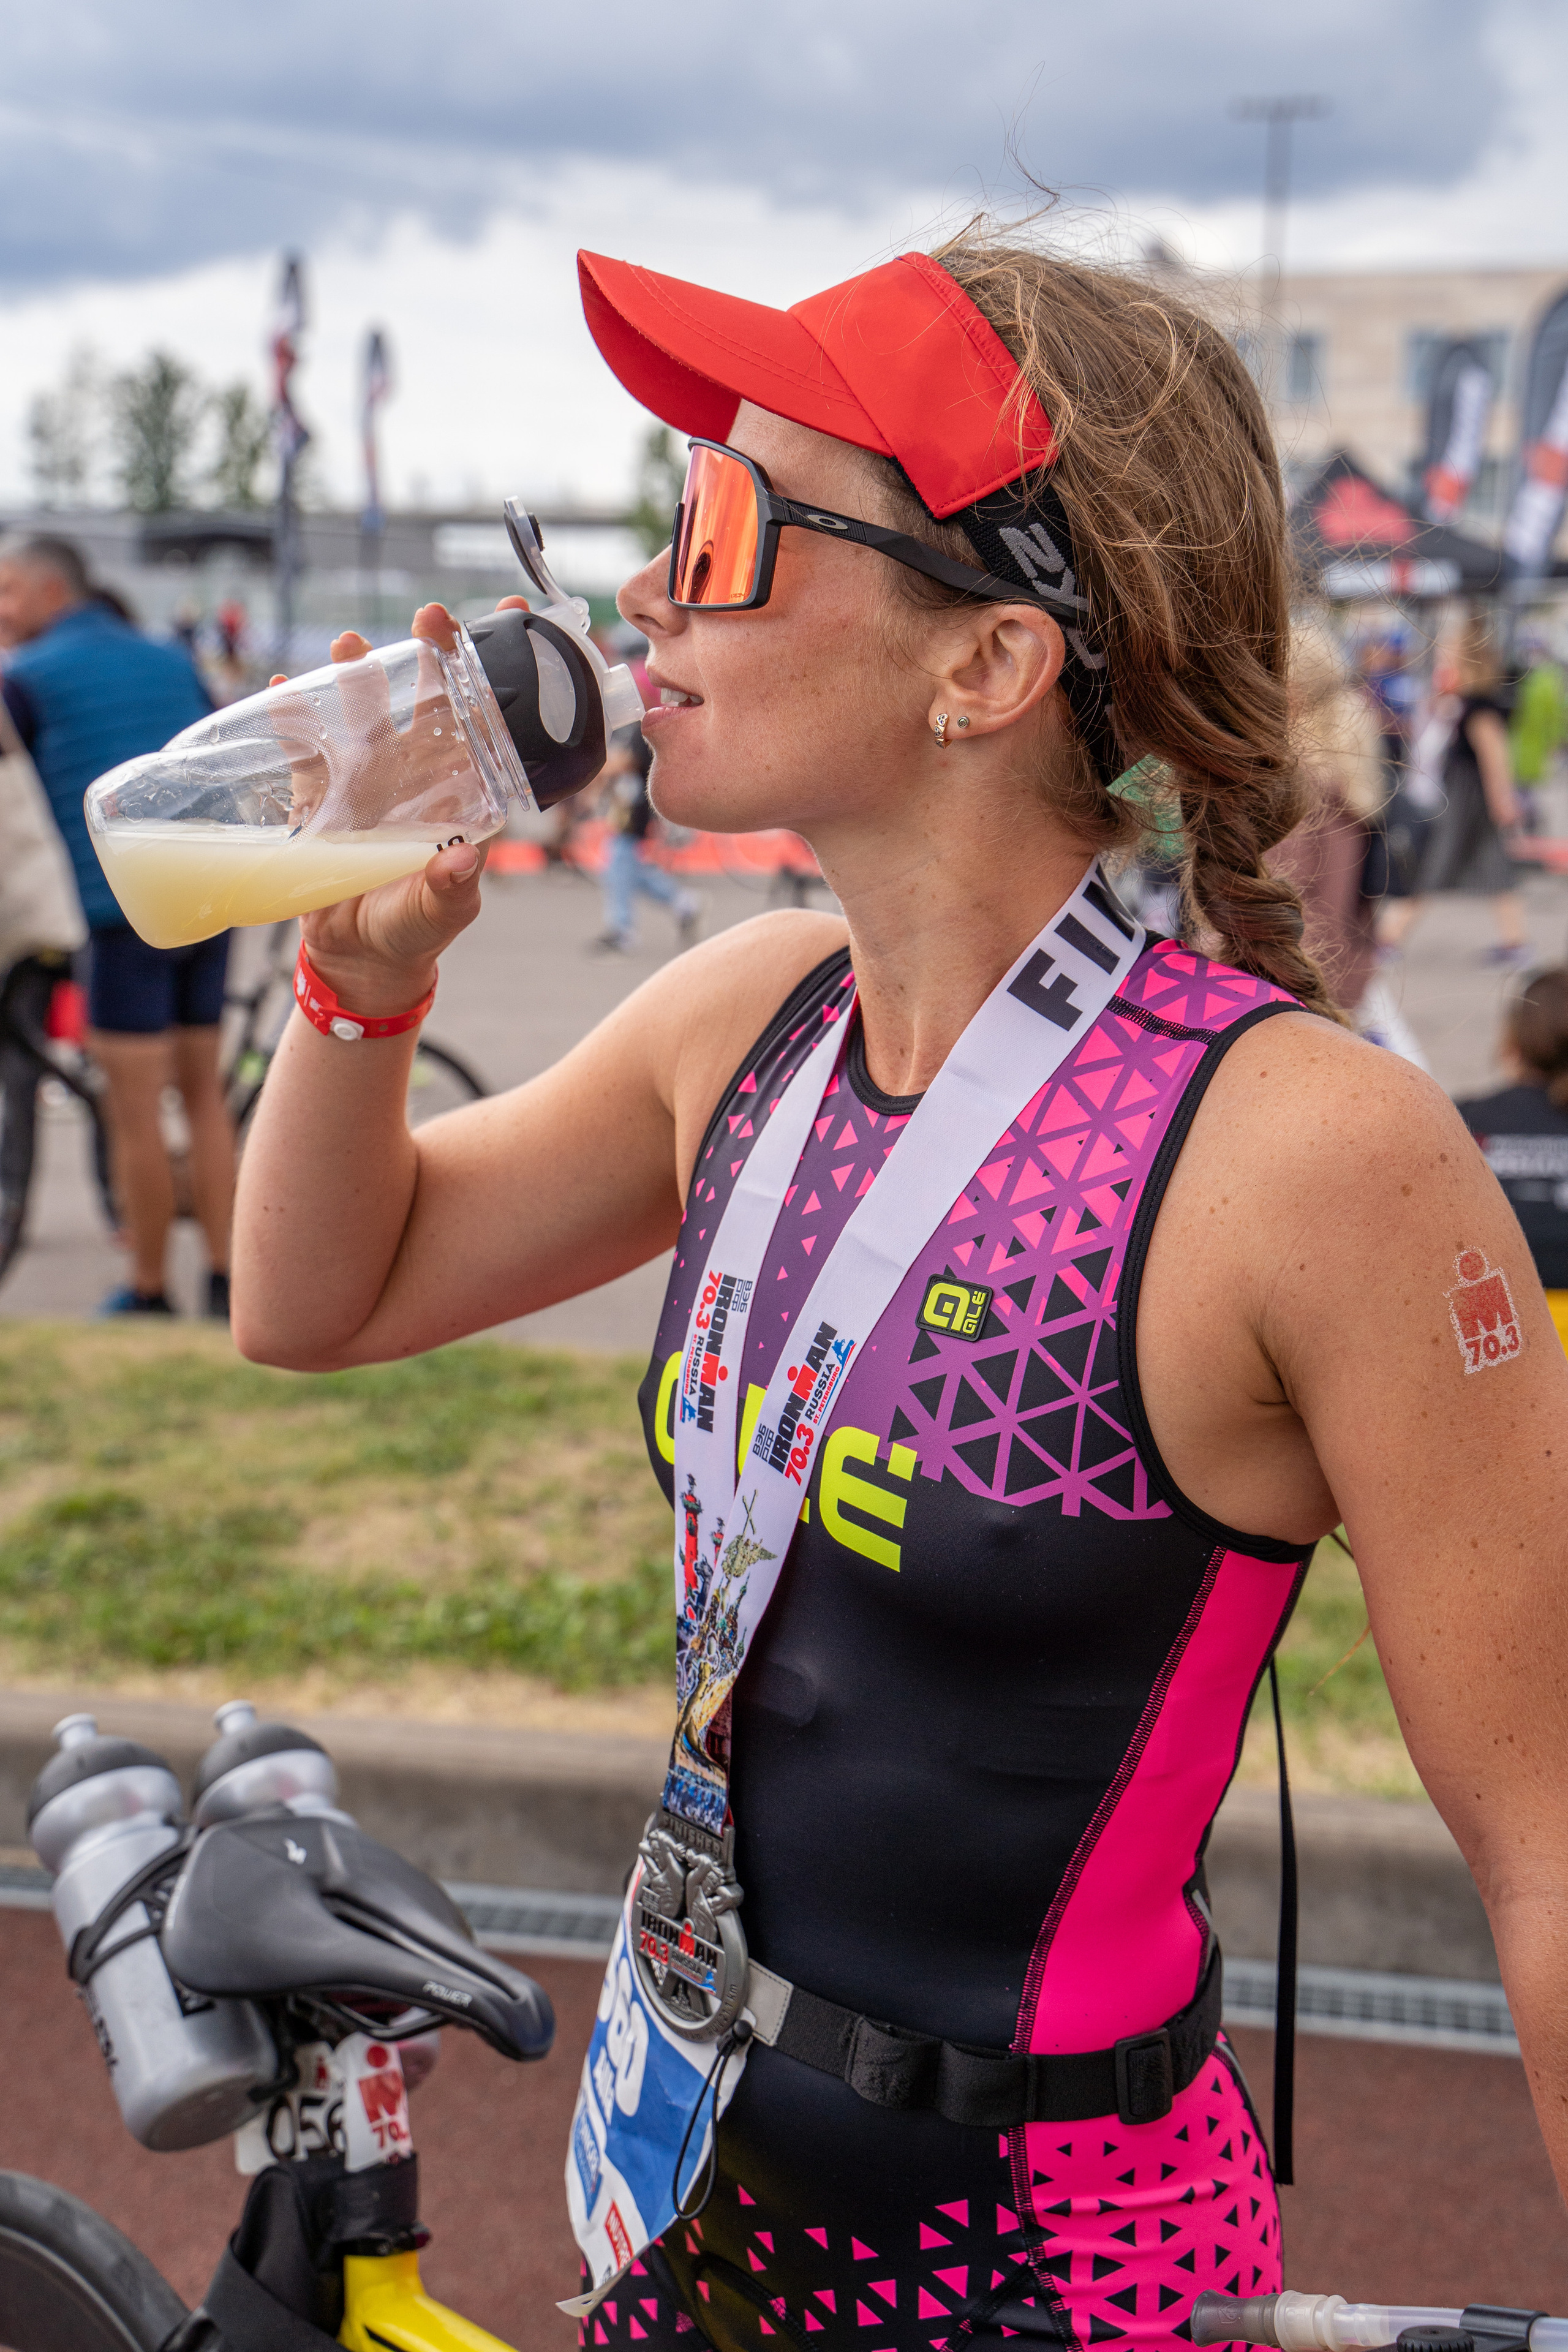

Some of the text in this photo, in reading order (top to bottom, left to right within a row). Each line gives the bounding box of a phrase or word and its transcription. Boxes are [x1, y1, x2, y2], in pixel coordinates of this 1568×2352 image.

[696, 1270, 722, 1330] 70.3
[684, 1344, 695, 1395] PETERSBURG
[688, 1336, 704, 1396] RUSSIA
[696, 1274, 737, 1433] IRONMAN
[1466, 1325, 1519, 1366] 70.3
[768, 1321, 838, 1474] IRONMAN
[805, 1363, 835, 1420] RUSSIA
[818, 1365, 840, 1412] PETERSBURG
[785, 1423, 814, 1487] 70.3
[663, 1815, 722, 1857] FINISHER
[639, 1931, 669, 1965] 70.3
[641, 1911, 718, 1972] IRONMAN
[423, 1981, 472, 2008] POWER
[727, 1983, 737, 2000] km
